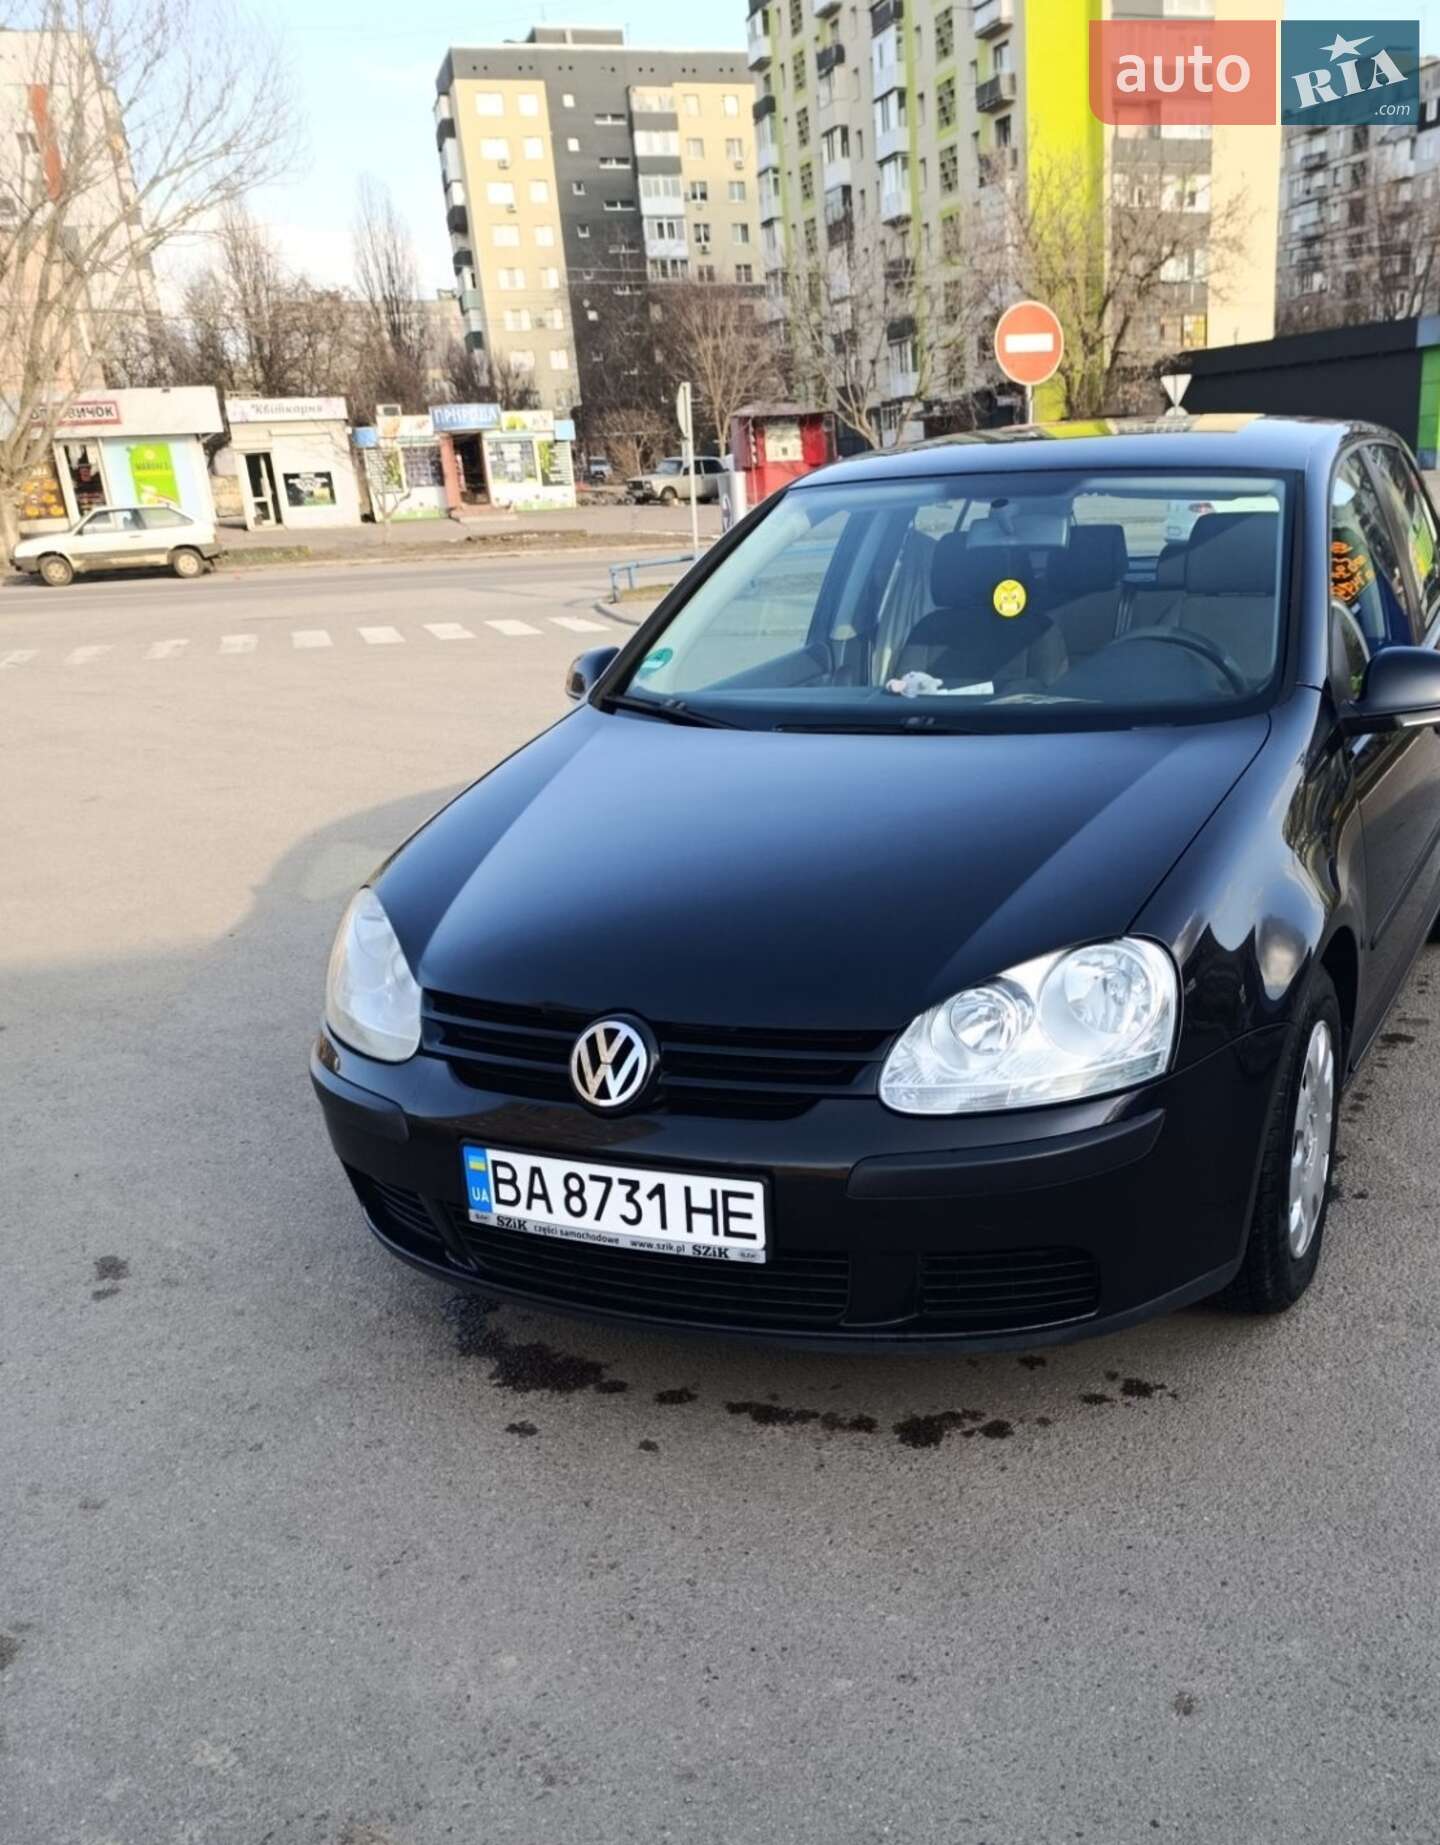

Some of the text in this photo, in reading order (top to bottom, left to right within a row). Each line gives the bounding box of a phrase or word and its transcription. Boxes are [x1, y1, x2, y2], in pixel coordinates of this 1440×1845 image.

[472, 1186, 489, 1204] UA
[491, 1159, 757, 1241] BA 8731 HE
[559, 1229, 620, 1245] samochodowe
[630, 1240, 685, 1254] www.szik.pl
